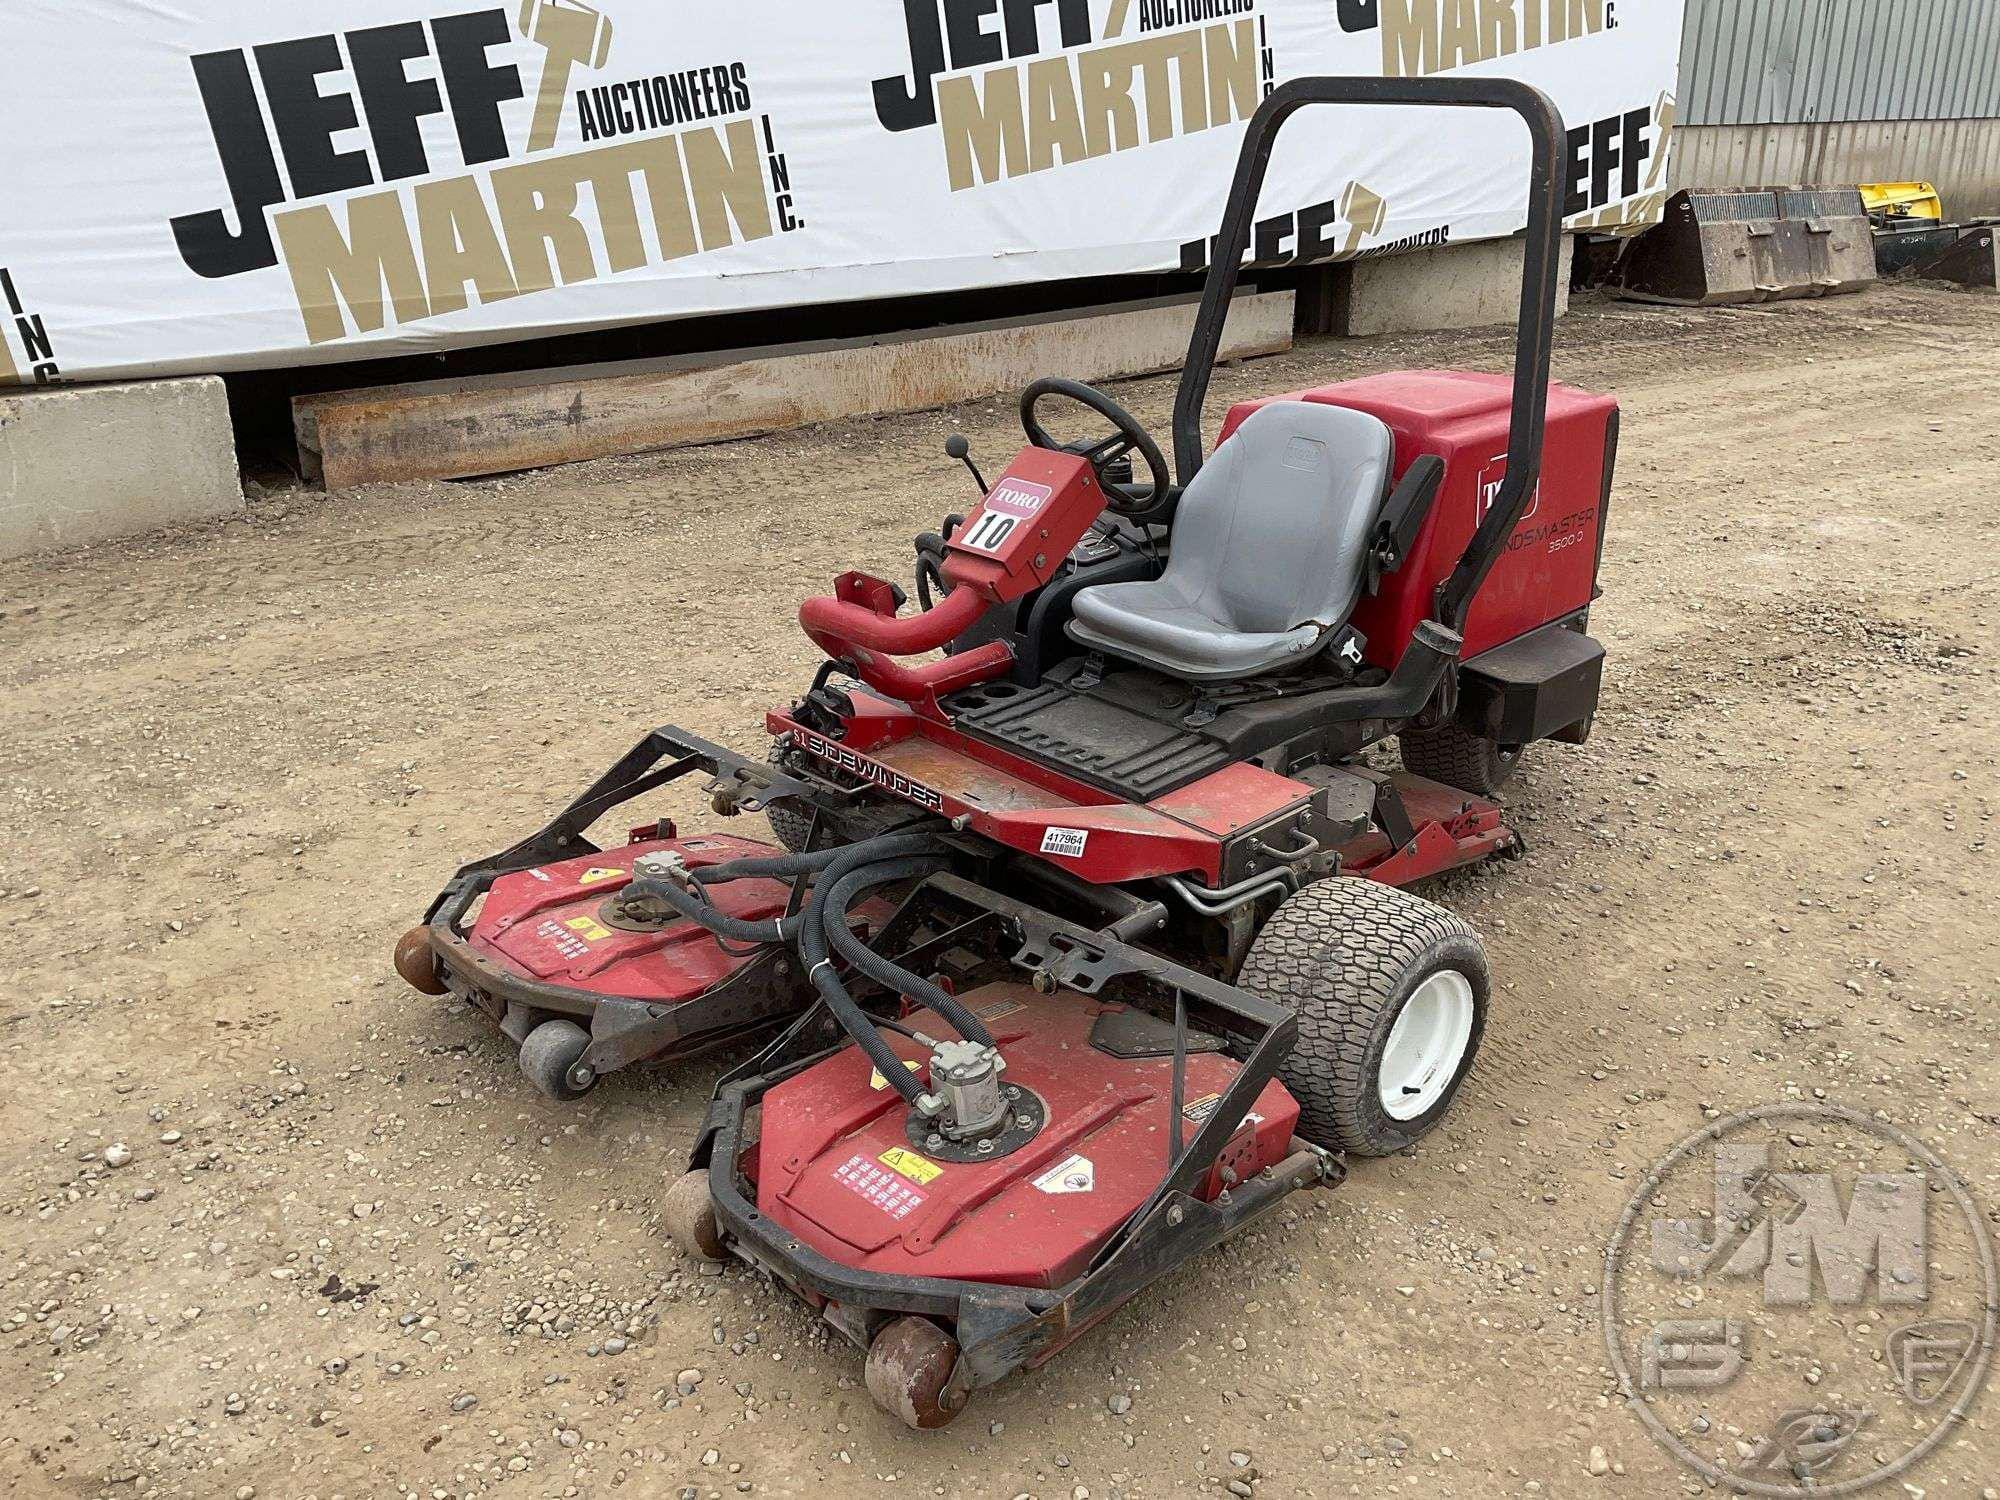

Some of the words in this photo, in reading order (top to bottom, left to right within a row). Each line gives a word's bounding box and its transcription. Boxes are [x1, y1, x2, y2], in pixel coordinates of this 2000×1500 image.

[576, 62, 751, 142] AUCTIONEERS
[936, 18, 1259, 192] MARTIN
[169, 8, 524, 278] JEFF
[761, 114, 805, 233] INC.
[273, 119, 774, 345] MARTIN
[970, 514, 1014, 549] 10
[996, 488, 1040, 510] TORO
[809, 737, 944, 813] SIDEWINDER
[1047, 832, 1083, 846] 417964
